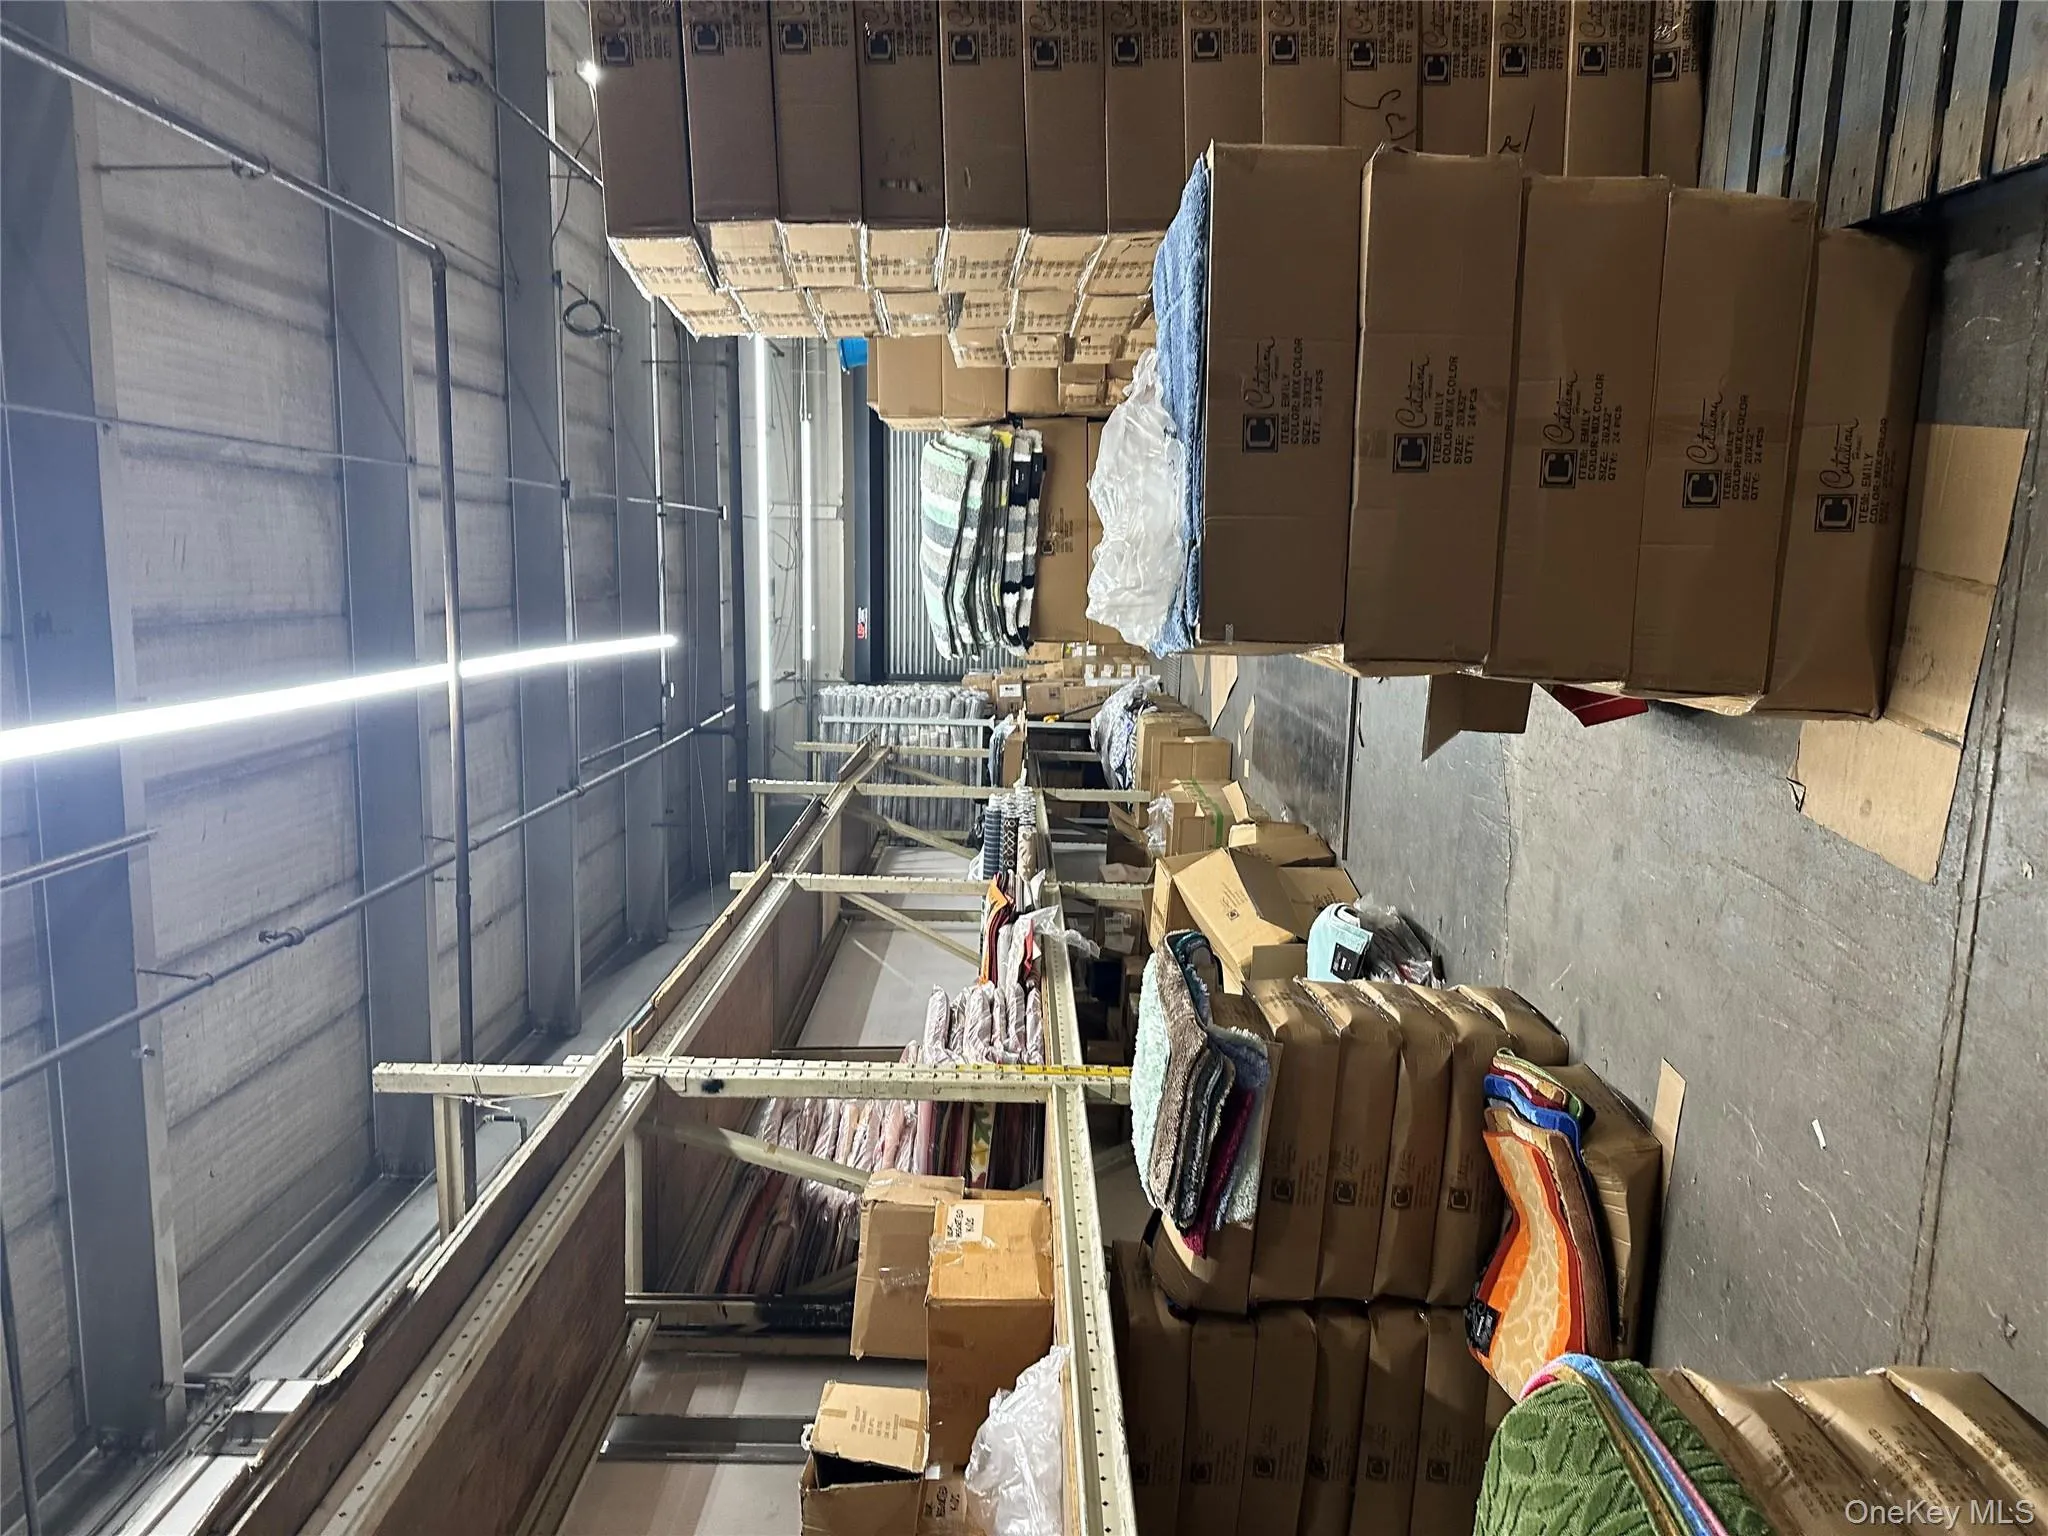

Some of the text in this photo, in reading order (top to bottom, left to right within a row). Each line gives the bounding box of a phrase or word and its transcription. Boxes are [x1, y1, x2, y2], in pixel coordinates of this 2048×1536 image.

[604, 37, 628, 61] C
[694, 24, 720, 50] C
[783, 25, 806, 48] C
[868, 32, 892, 57] C
[952, 36, 975, 60] C
[1115, 37, 1138, 61] C
[1195, 32, 1218, 56] C
[1273, 35, 1295, 59] C
[1034, 41, 1057, 66] C
[1351, 42, 1373, 65] C
[1502, 48, 1525, 72] C
[1582, 46, 1604, 71] C
[1652, 52, 1676, 77] C
[1425, 56, 1447, 80] C
[1293, 337, 1303, 377] COLOR
[1447, 356, 1458, 395] COLOR
[1281, 374, 1290, 408] EMILY
[1593, 374, 1605, 412] COLOR
[1434, 392, 1443, 426] EMILY
[1736, 395, 1748, 433] COLOR
[1246, 418, 1275, 447] C
[1580, 409, 1590, 442] EMILY
[1612, 432, 1620, 443] 24
[1877, 418, 1887, 457] COLOR
[1397, 438, 1427, 467] C
[1724, 430, 1734, 463] EMILY
[1755, 452, 1762, 463] 24
[1544, 454, 1573, 482] C
[1861, 453, 1873, 487] EMILY
[1687, 474, 1717, 503] C
[1819, 498, 1852, 527] C
[1336, 1183, 1355, 1203] C
